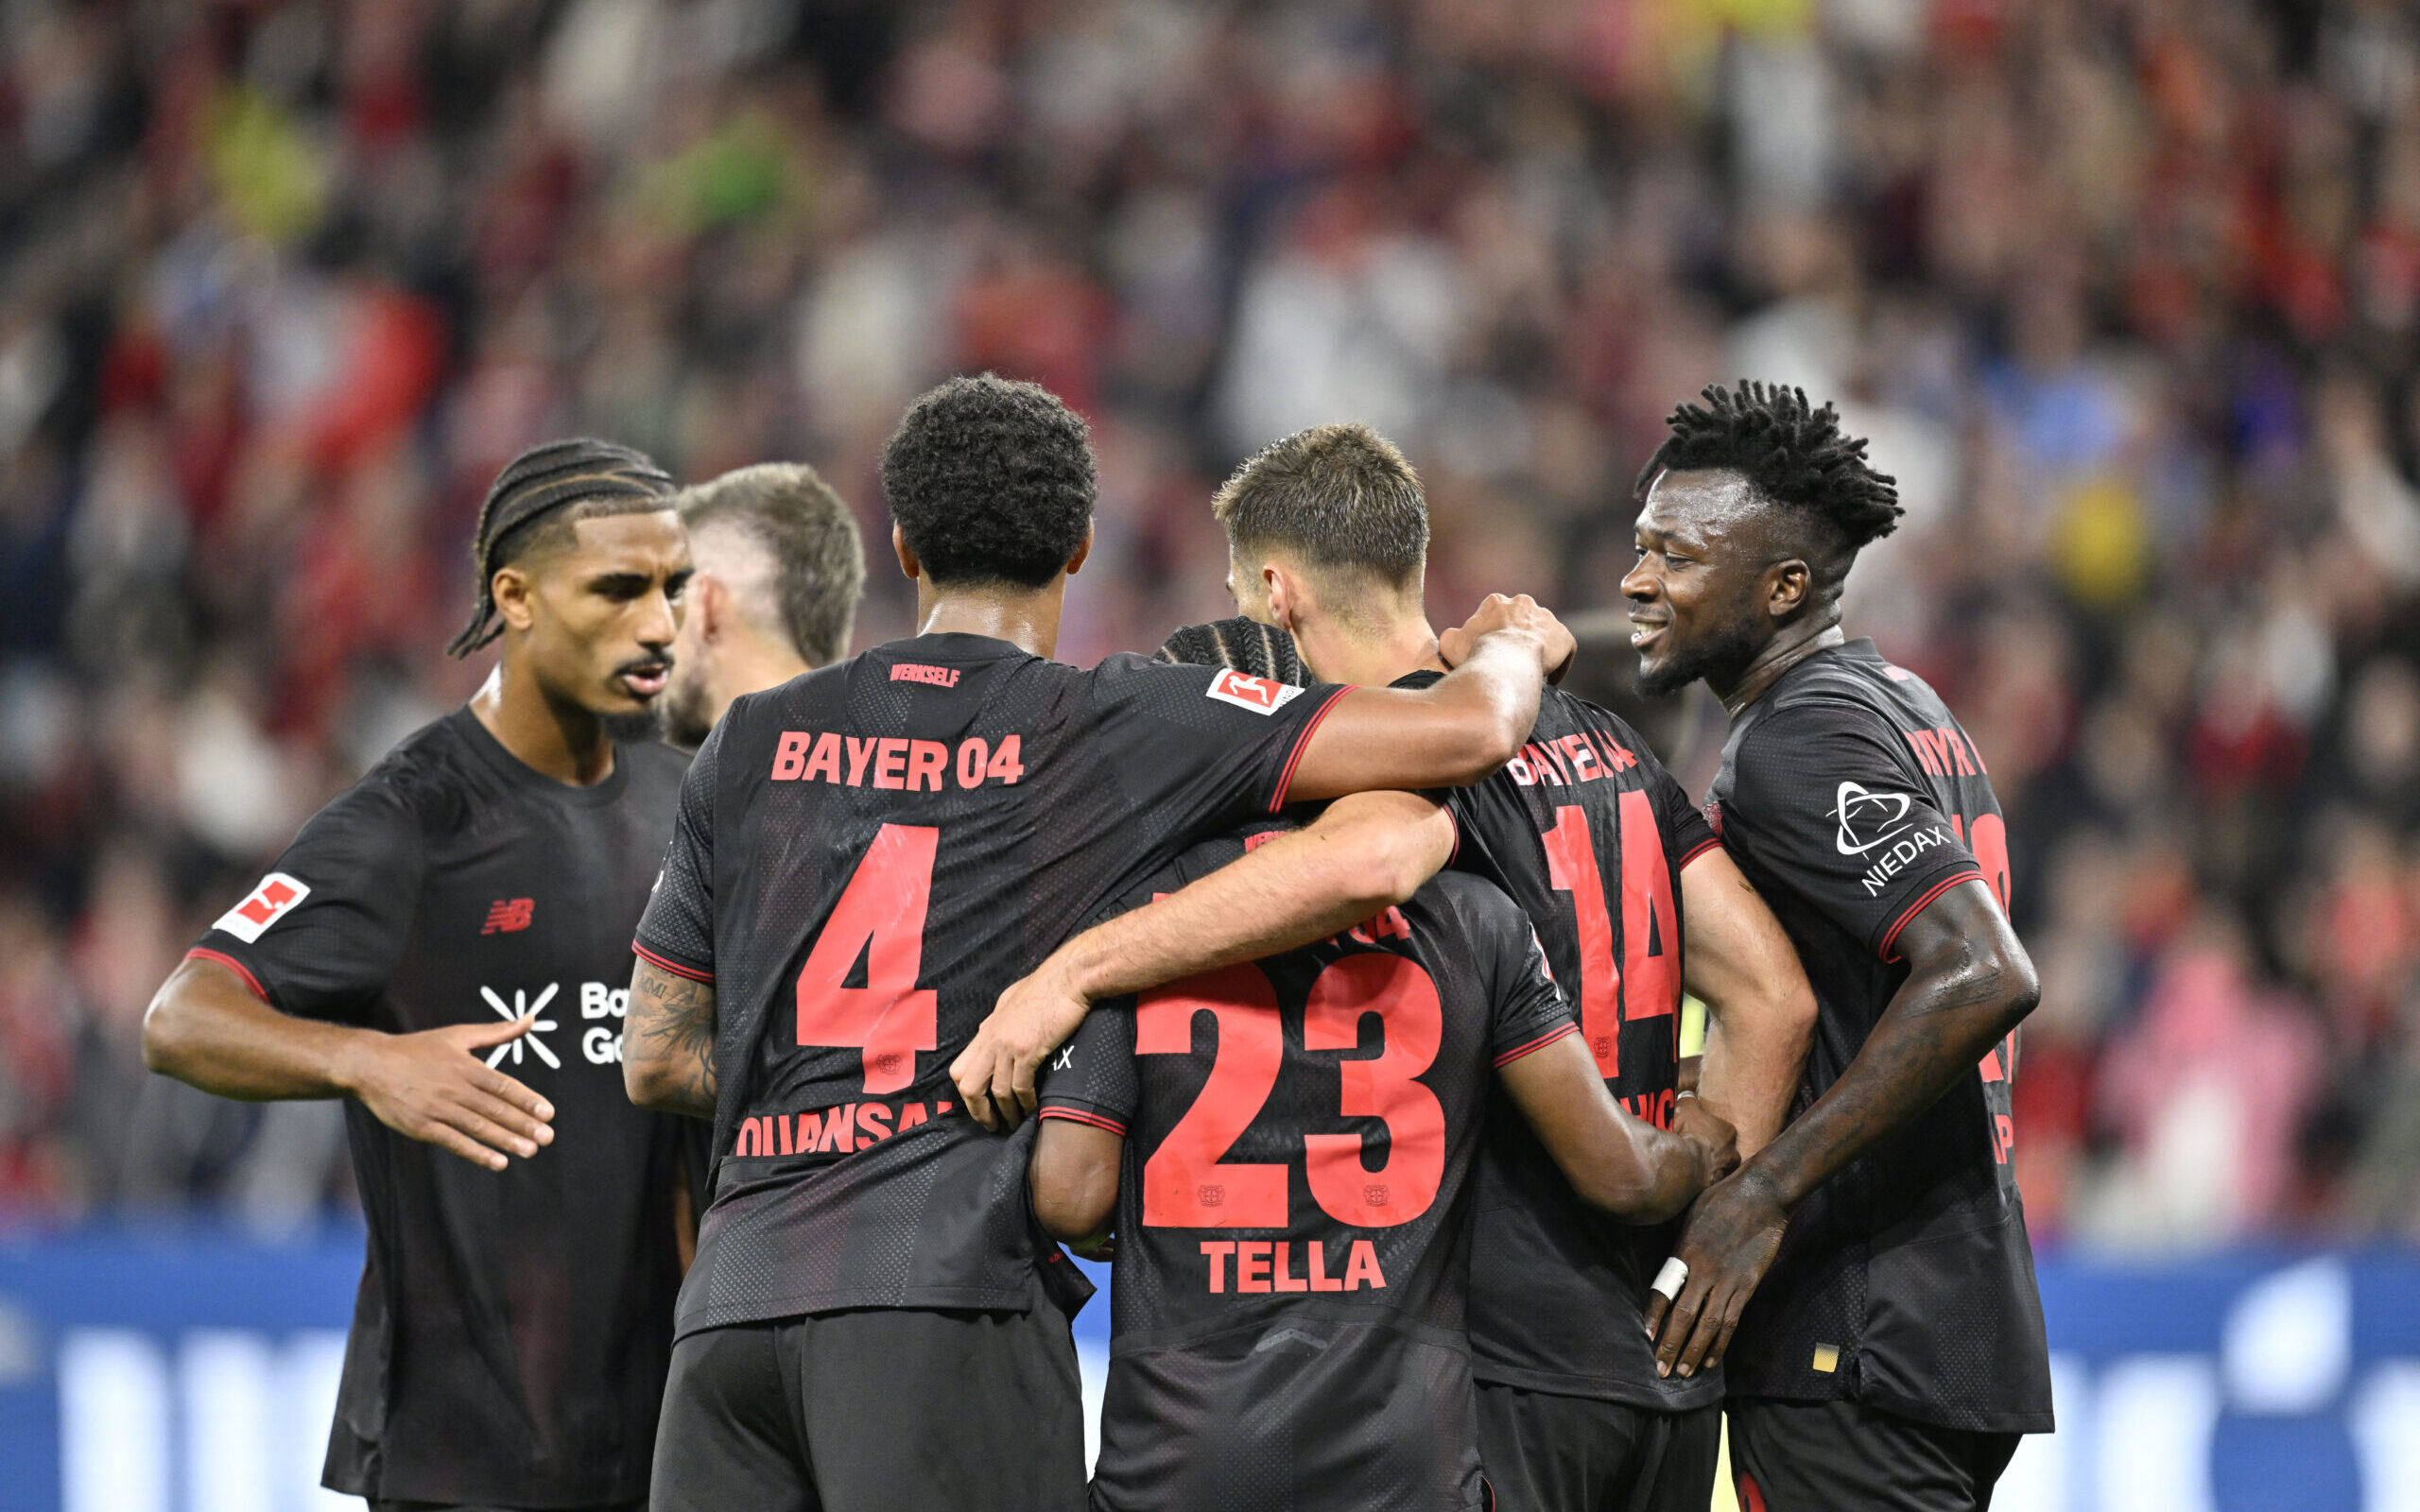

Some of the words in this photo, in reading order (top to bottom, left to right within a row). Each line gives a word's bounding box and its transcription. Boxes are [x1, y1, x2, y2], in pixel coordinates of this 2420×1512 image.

[771, 731, 947, 791] BAYER
[957, 734, 1023, 788] 04
[1861, 826, 1951, 897] NIEDAX
[796, 822, 939, 1094] 4
[1542, 789, 1681, 1079] 14
[1135, 952, 1445, 1228] 23
[736, 1101, 952, 1157] QUANSA
[1200, 1240, 1387, 1294] TELLA
